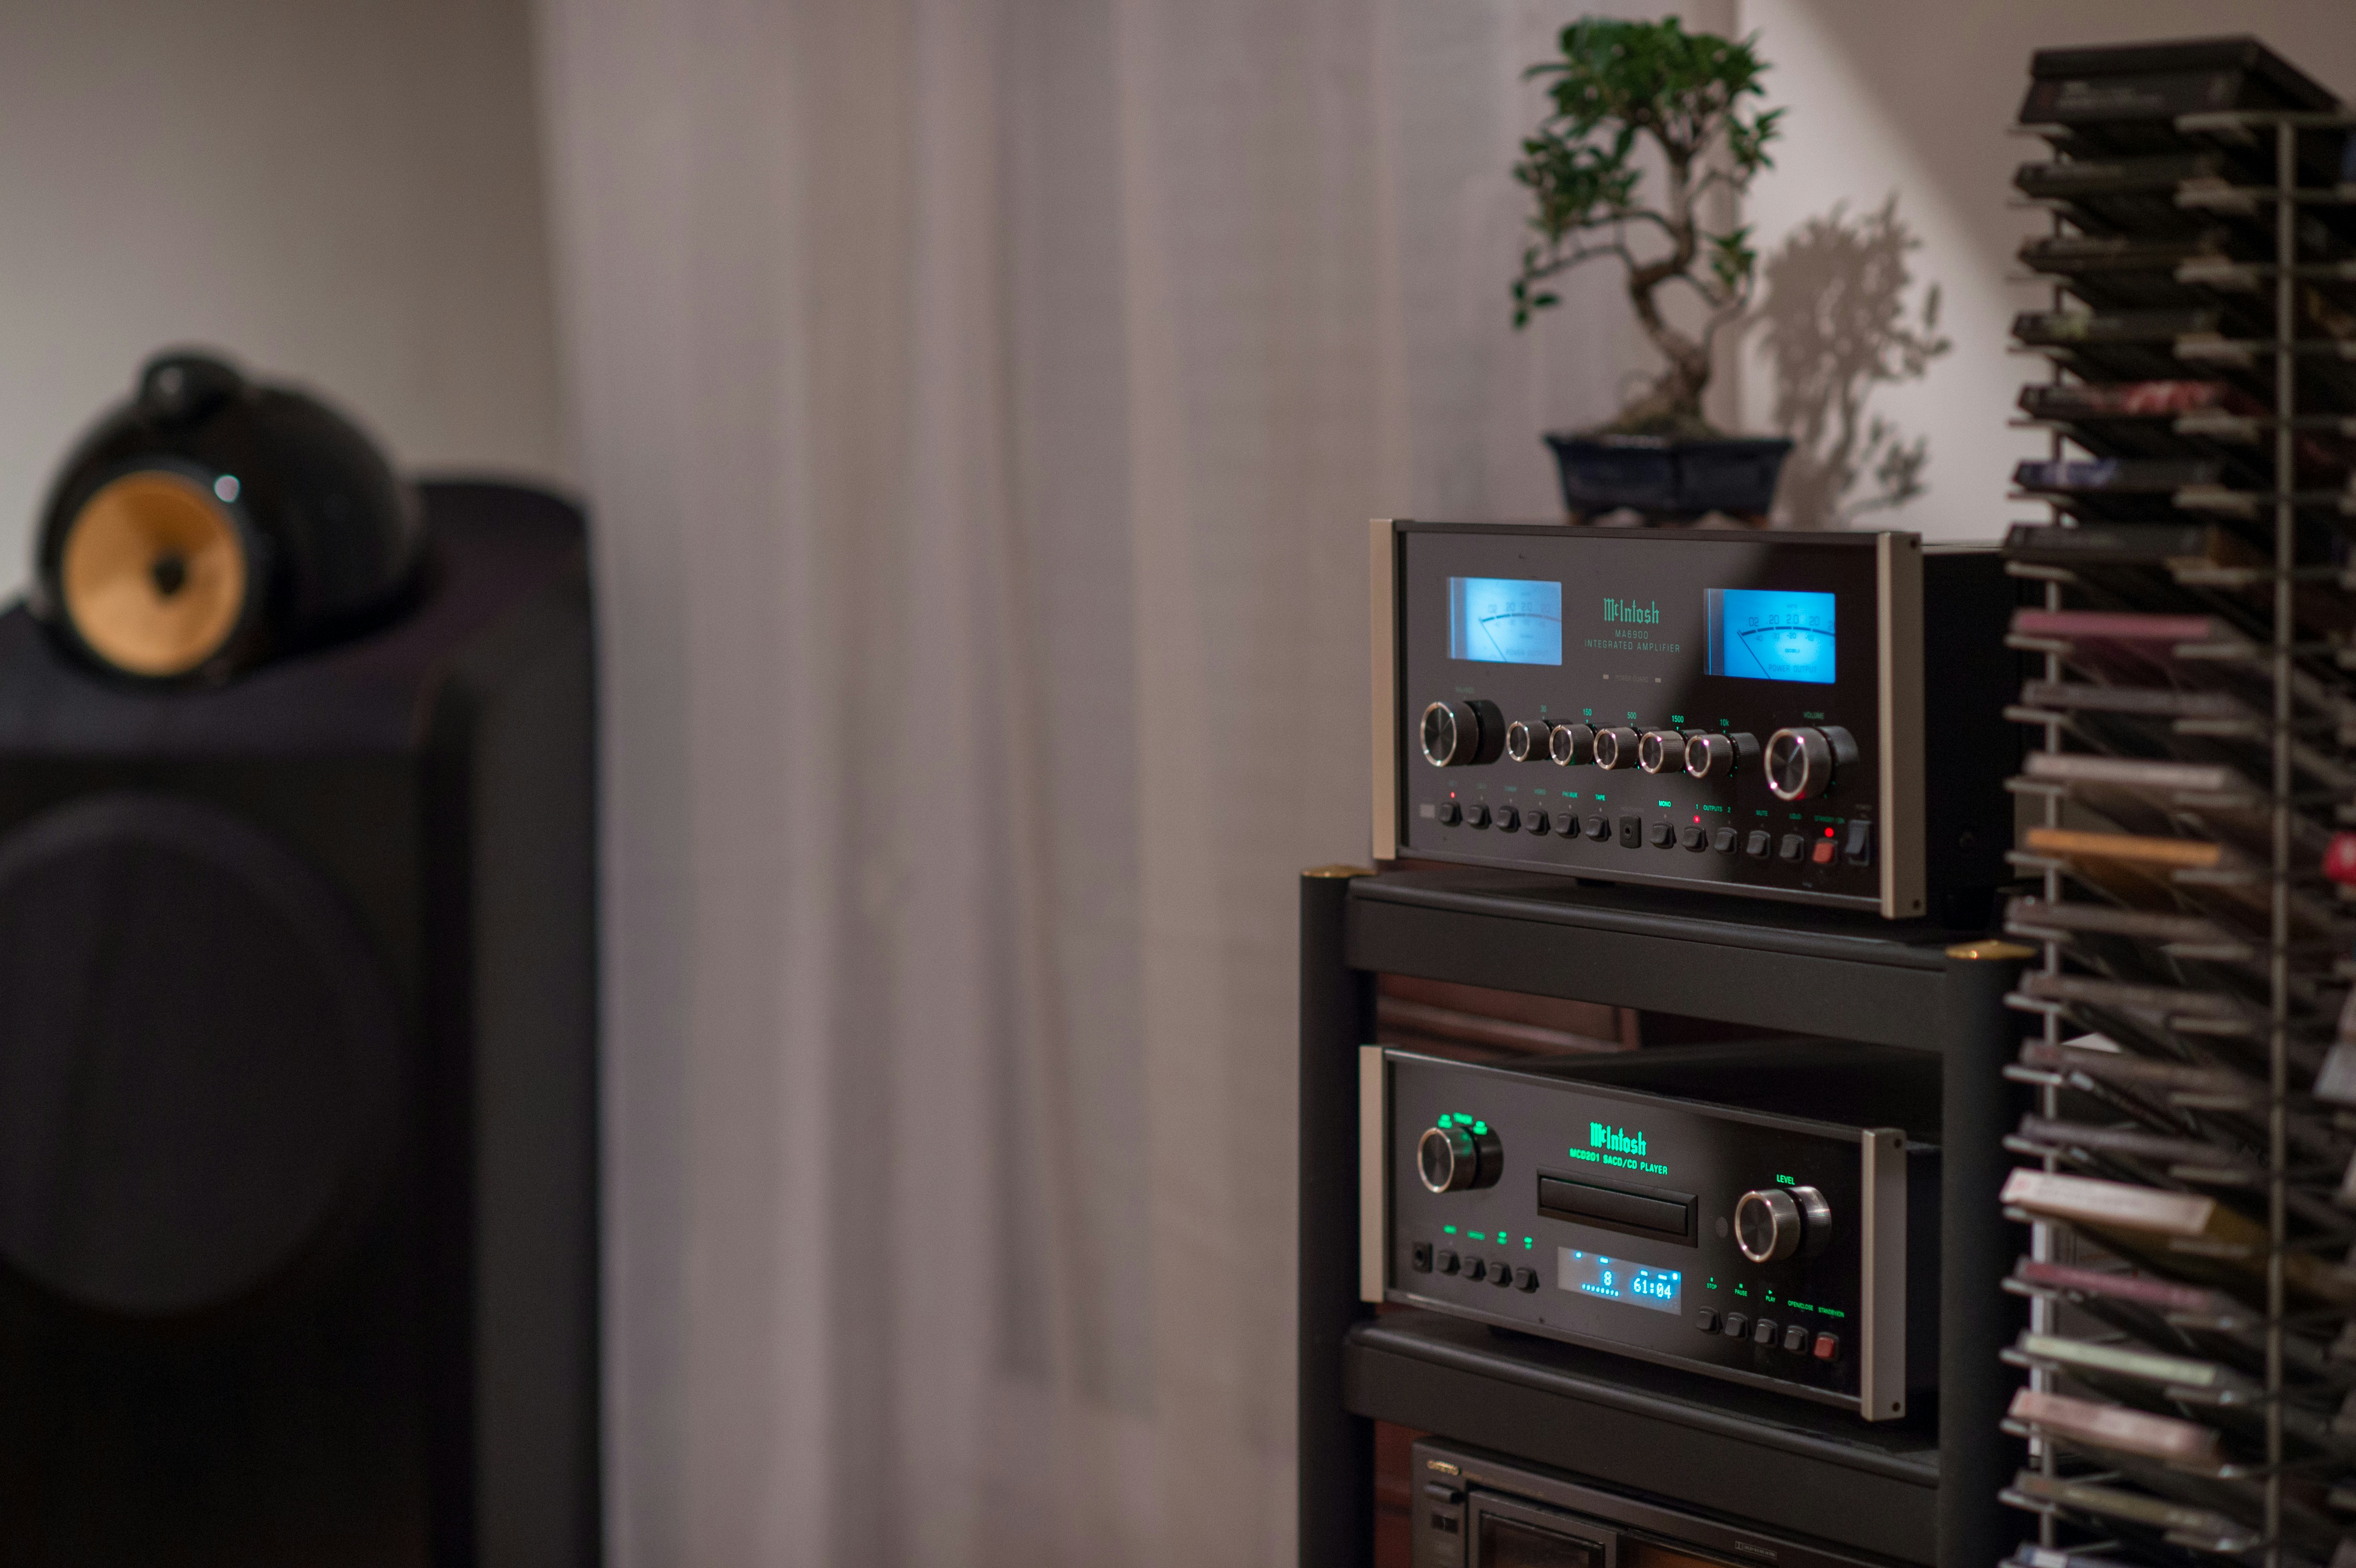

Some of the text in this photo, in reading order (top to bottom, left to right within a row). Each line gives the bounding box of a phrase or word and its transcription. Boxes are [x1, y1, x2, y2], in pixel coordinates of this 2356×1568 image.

[1603, 598, 1660, 624] McIntosh
[1615, 629, 1649, 639] MA6900
[1584, 639, 1680, 653] INTEGRATED AMPLIFIER
[1768, 664, 1817, 674] POWER OUTPUT
[1582, 708, 1592, 716] 150
[1627, 711, 1637, 719] 500
[1672, 715, 1684, 723] 1500
[1590, 1122, 1647, 1156] McIntosh
[1569, 1147, 1668, 1176] MCD201 SACD/CD PLAYER
[1777, 1174, 1796, 1185] LEVEL
[1603, 1271, 1612, 1286] 8
[1633, 1278, 1671, 1299] 61:04
[1734, 1288, 1748, 1296] PAUSE
[1787, 1300, 1814, 1311] OPEN/CLOSE
[1818, 1307, 1845, 1318] STANDBY/ON
